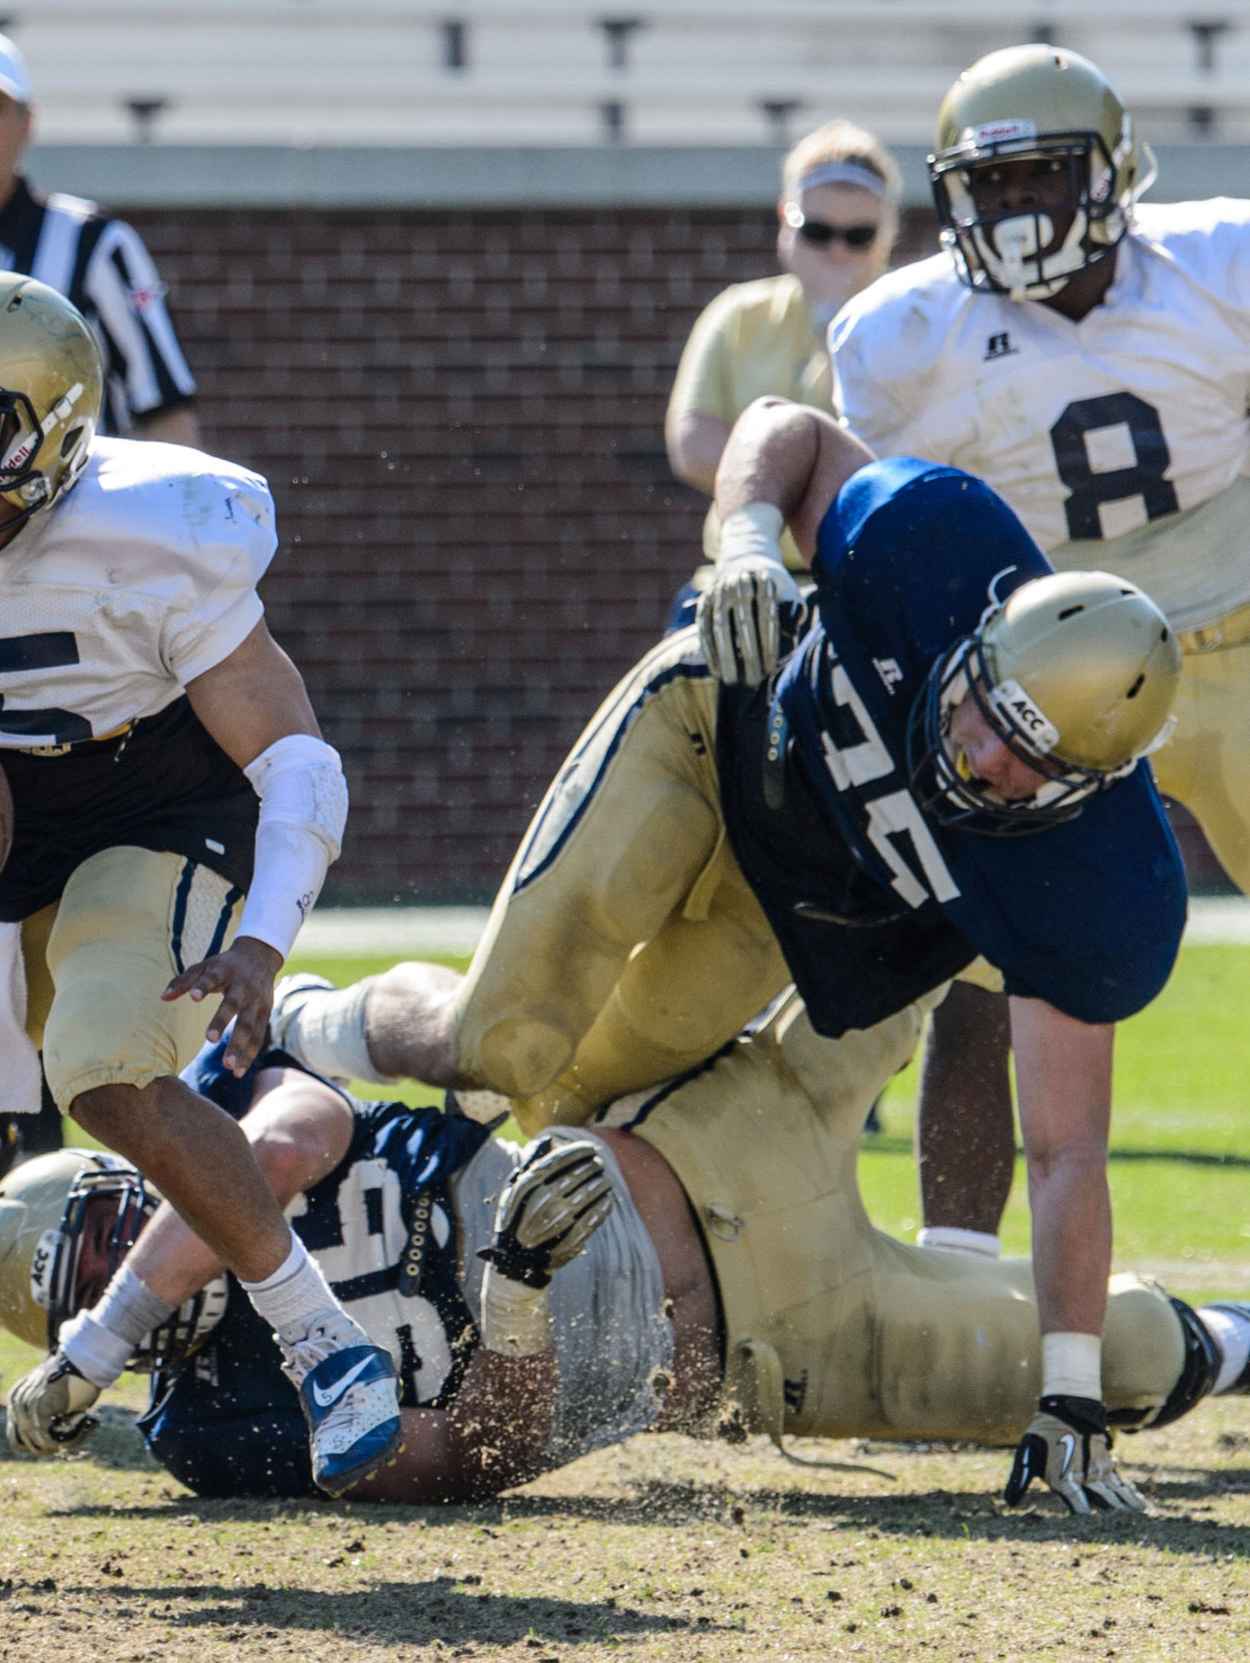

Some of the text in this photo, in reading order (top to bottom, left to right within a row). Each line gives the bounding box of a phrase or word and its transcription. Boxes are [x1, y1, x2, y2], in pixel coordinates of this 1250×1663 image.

[1050, 391, 1180, 540] 8
[1011, 701, 1045, 731] ACC
[32, 1248, 49, 1287] ACC
[321, 1391, 333, 1404] 5
